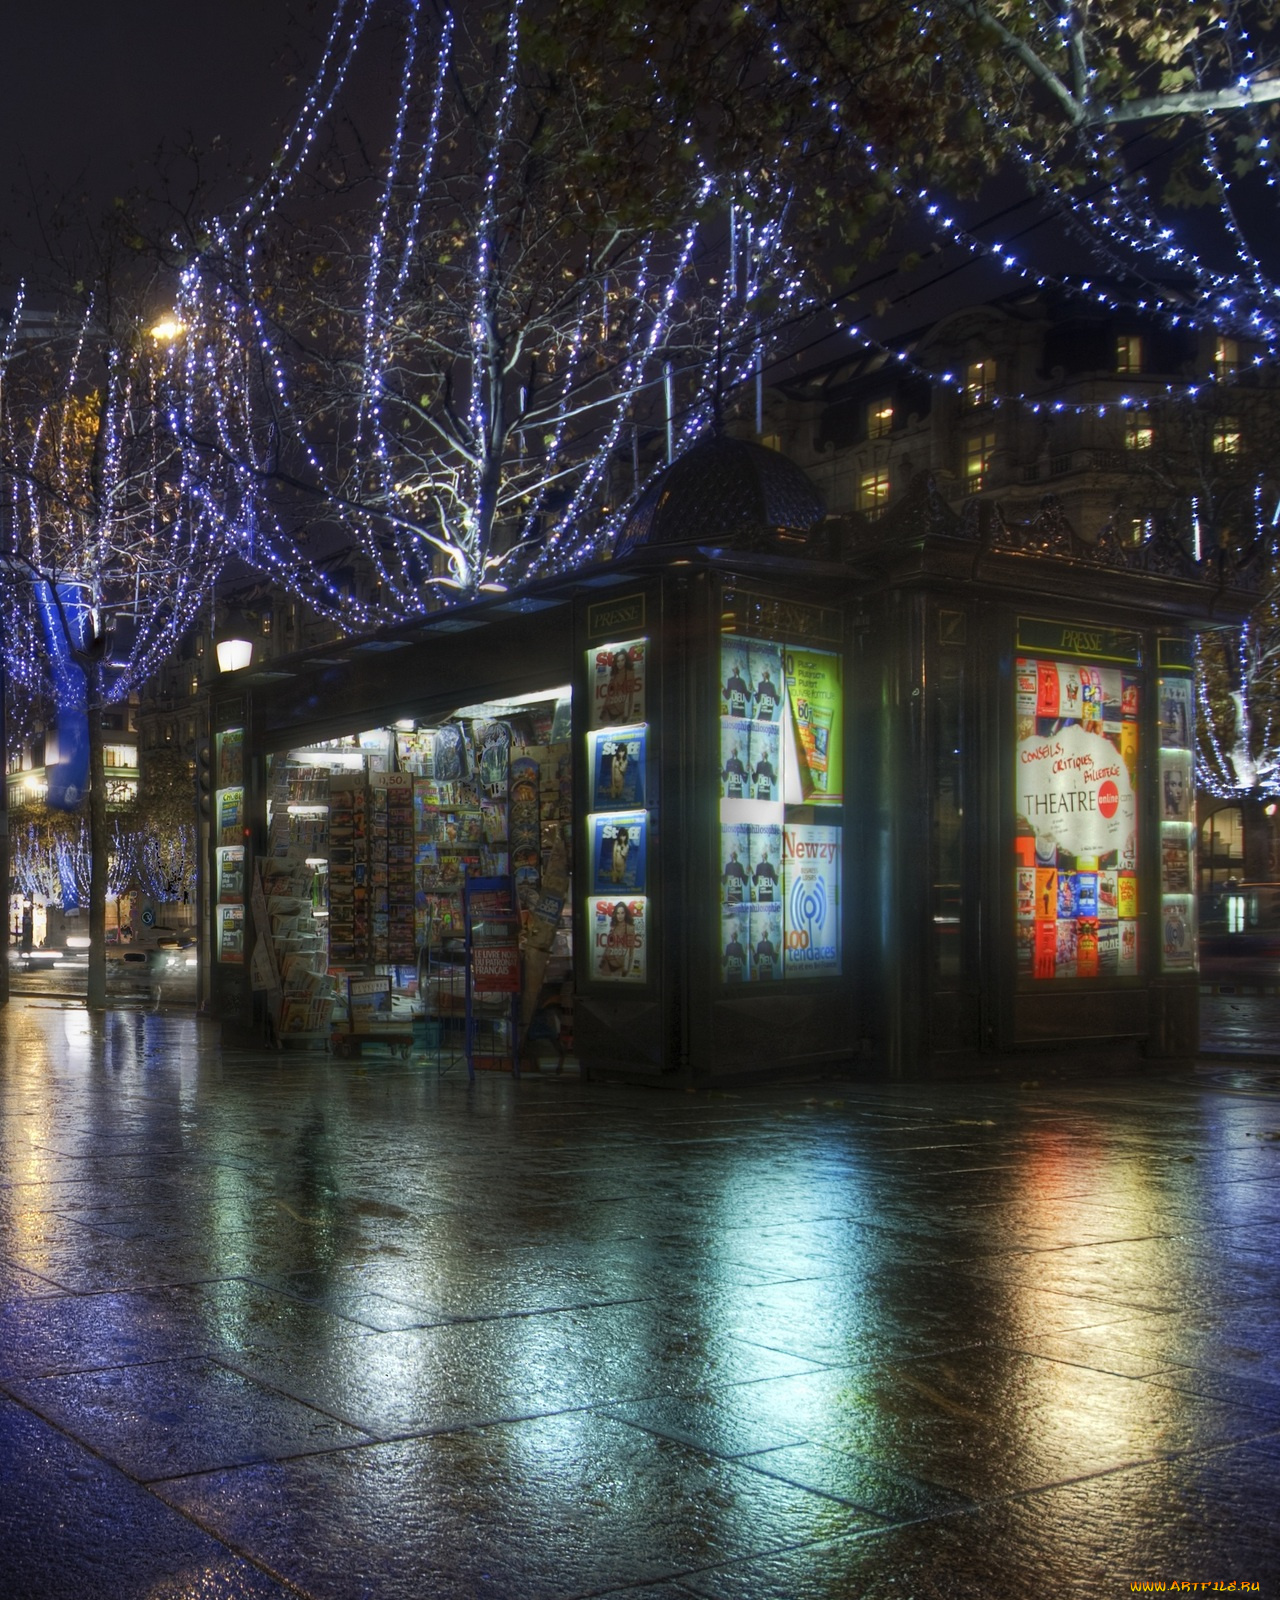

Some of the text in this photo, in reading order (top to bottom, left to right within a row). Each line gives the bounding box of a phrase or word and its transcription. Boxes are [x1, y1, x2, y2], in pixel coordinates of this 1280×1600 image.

[1061, 629, 1103, 652] PRESSE
[596, 678, 643, 700] ICONES
[602, 741, 641, 756] Stff
[1024, 791, 1097, 816] THEATRE
[602, 825, 642, 840] Stff
[782, 831, 837, 865] Newzy
[596, 932, 643, 949] ICONES
[474, 950, 482, 959] LE
[482, 950, 501, 959] LIVRE
[474, 959, 485, 967] DU
